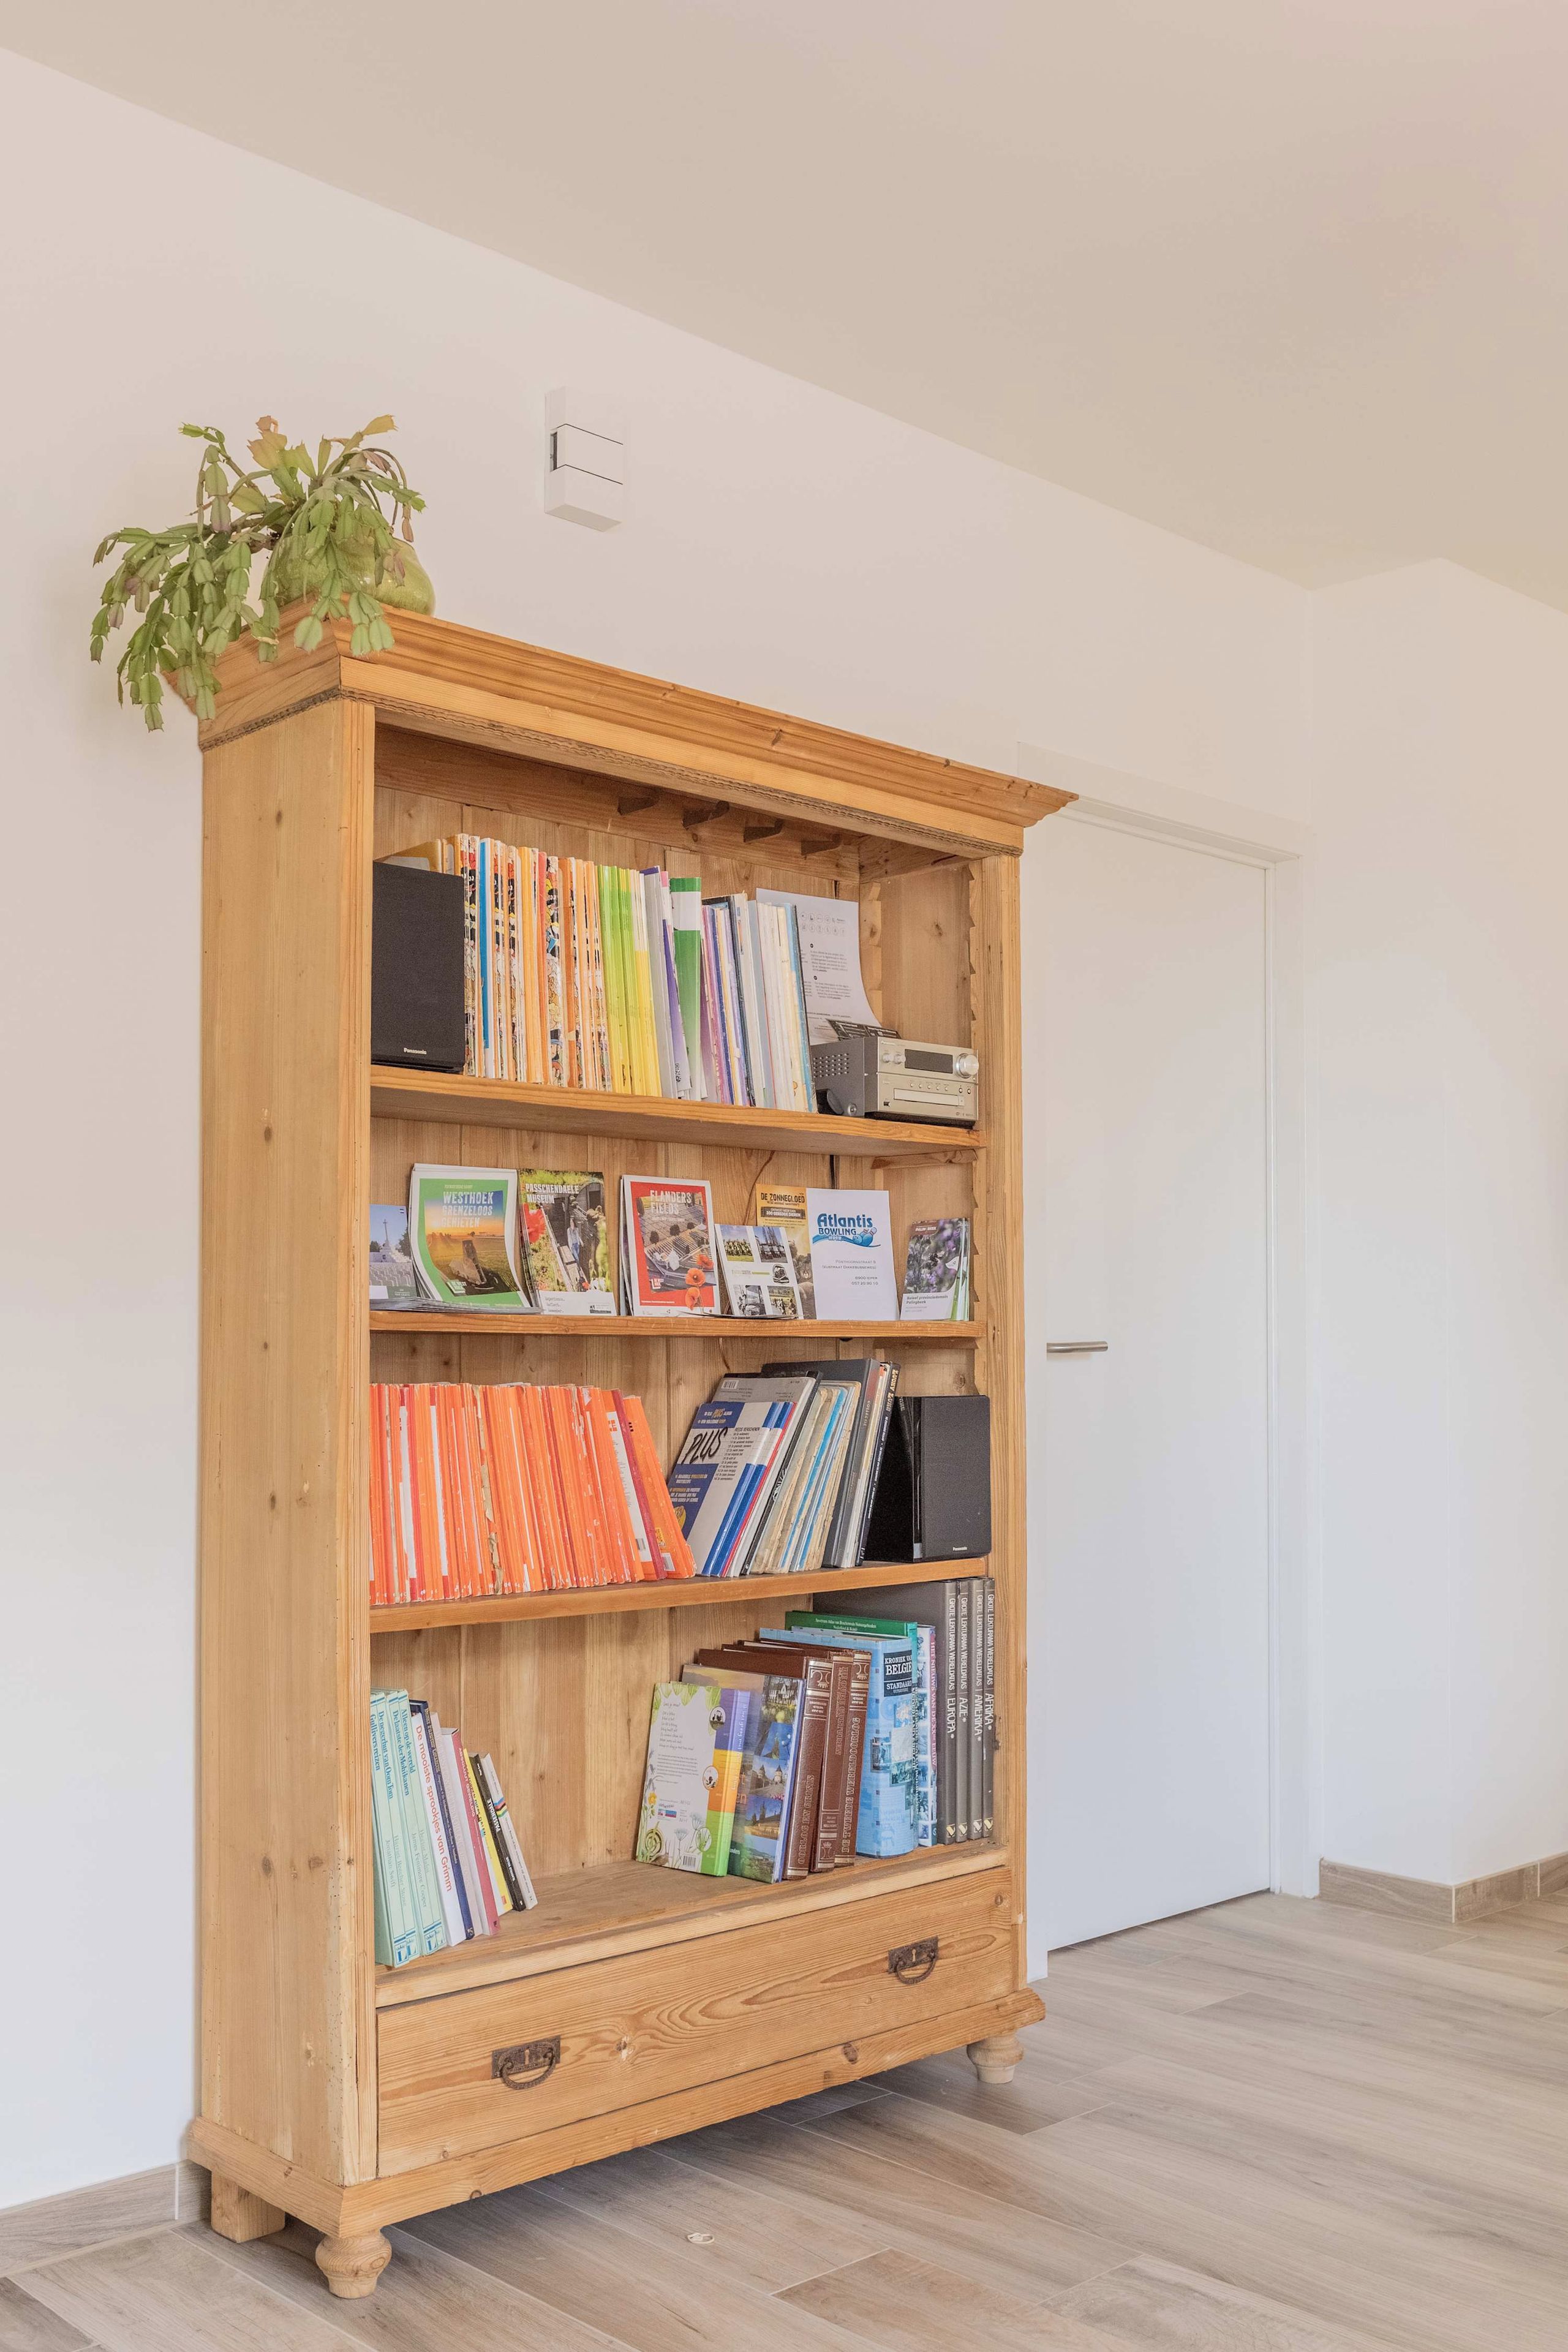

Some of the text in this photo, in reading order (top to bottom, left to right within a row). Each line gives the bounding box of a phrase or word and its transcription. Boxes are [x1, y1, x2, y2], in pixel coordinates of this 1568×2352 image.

[526, 1183, 579, 1194] PASSCHENDAELE
[443, 1191, 494, 1204] WESTHOEK
[527, 1194, 555, 1204] MUSEUM
[650, 1190, 692, 1204] FLANDERS
[770, 1194, 805, 1203] ZONNEGLOED
[442, 1205, 492, 1216] GRENZELOOS
[651, 1202, 679, 1214] FIELDS
[818, 1213, 873, 1227] Atlantis
[681, 1427, 728, 1465] PLUS
[379, 1711, 384, 1721] De
[985, 1693, 994, 1725] AFRIKA
[379, 1721, 388, 1752] negerhut
[393, 1710, 399, 1720] De
[399, 1756, 410, 1796] Mohikanen
[459, 1748, 475, 1817] ABSOLUUT GEWELDIG
[842, 1840, 850, 1853] DE
[846, 1717, 860, 1795] WERELDOORLOG
[804, 1775, 814, 1808] CRISIS
[416, 1725, 422, 1740] De
[420, 1743, 431, 1784] mooiste
[426, 1786, 440, 1834] sprookjes
[441, 1856, 451, 1891] Grimm
[487, 1798, 501, 1832] PASSENDALE
[802, 1809, 810, 1823] EN
